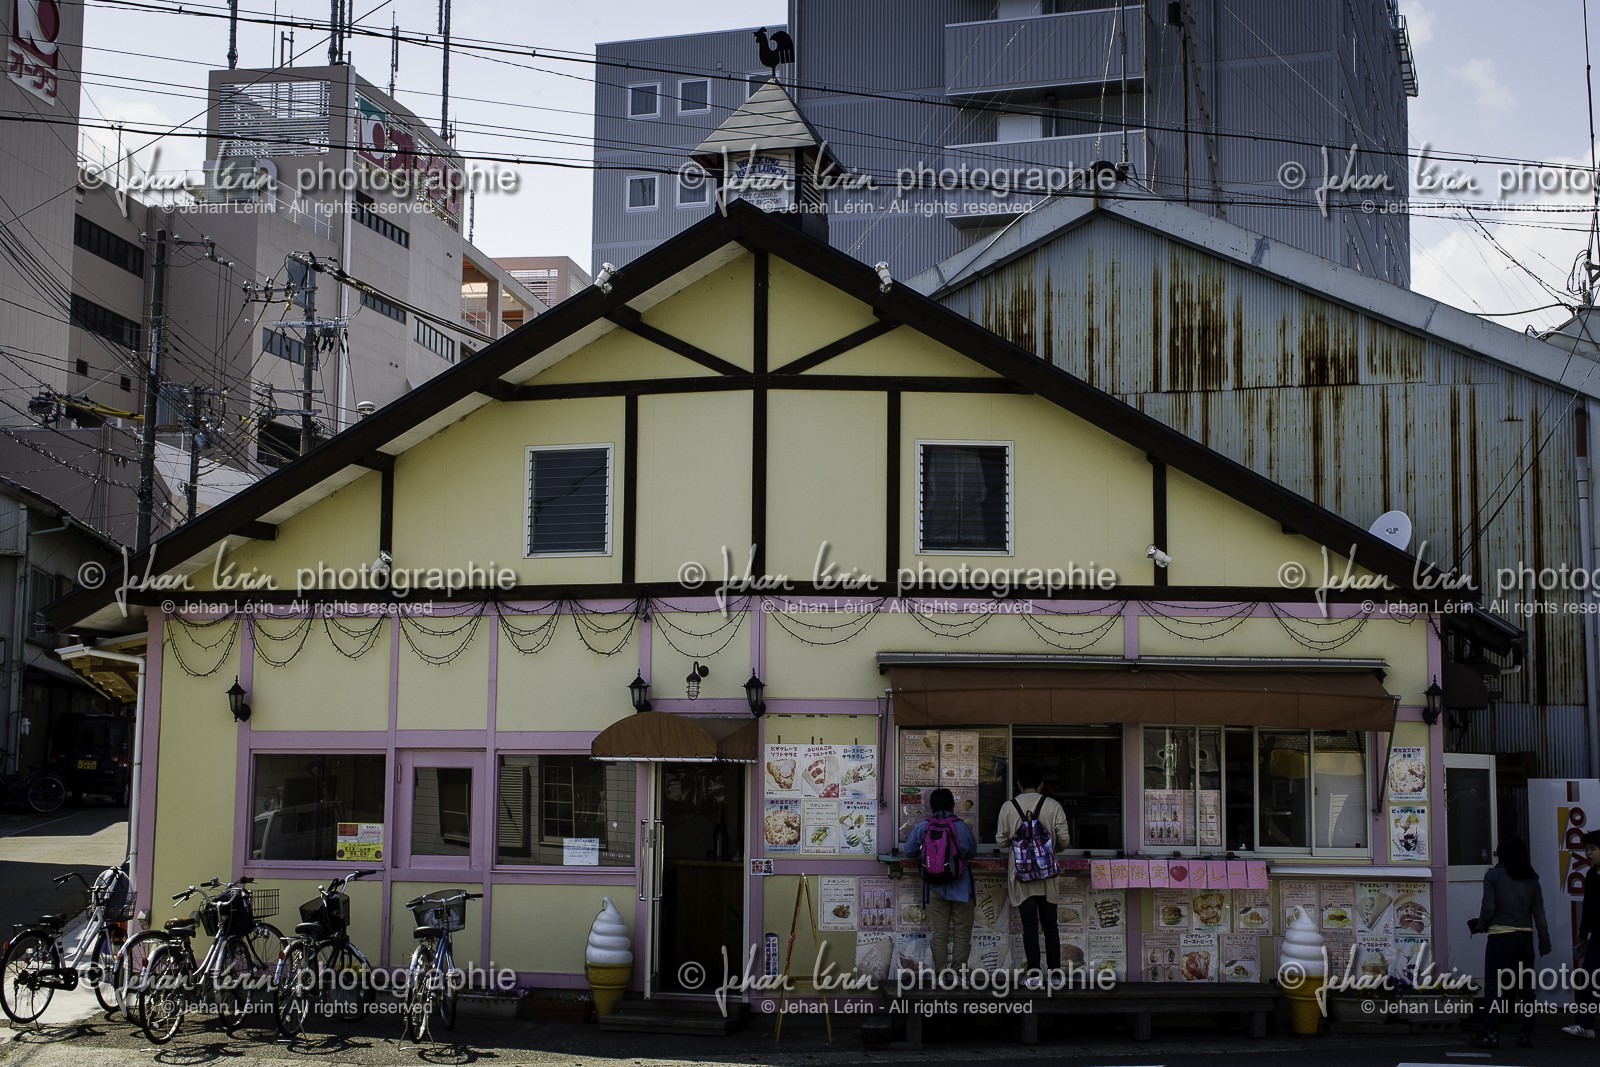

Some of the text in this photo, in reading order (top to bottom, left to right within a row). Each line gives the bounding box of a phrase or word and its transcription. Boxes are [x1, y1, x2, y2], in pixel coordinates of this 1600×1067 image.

[10, 50, 57, 97] オークワ
[1093, 864, 1168, 881] 季節限定
[1192, 866, 1266, 881] クレープ
